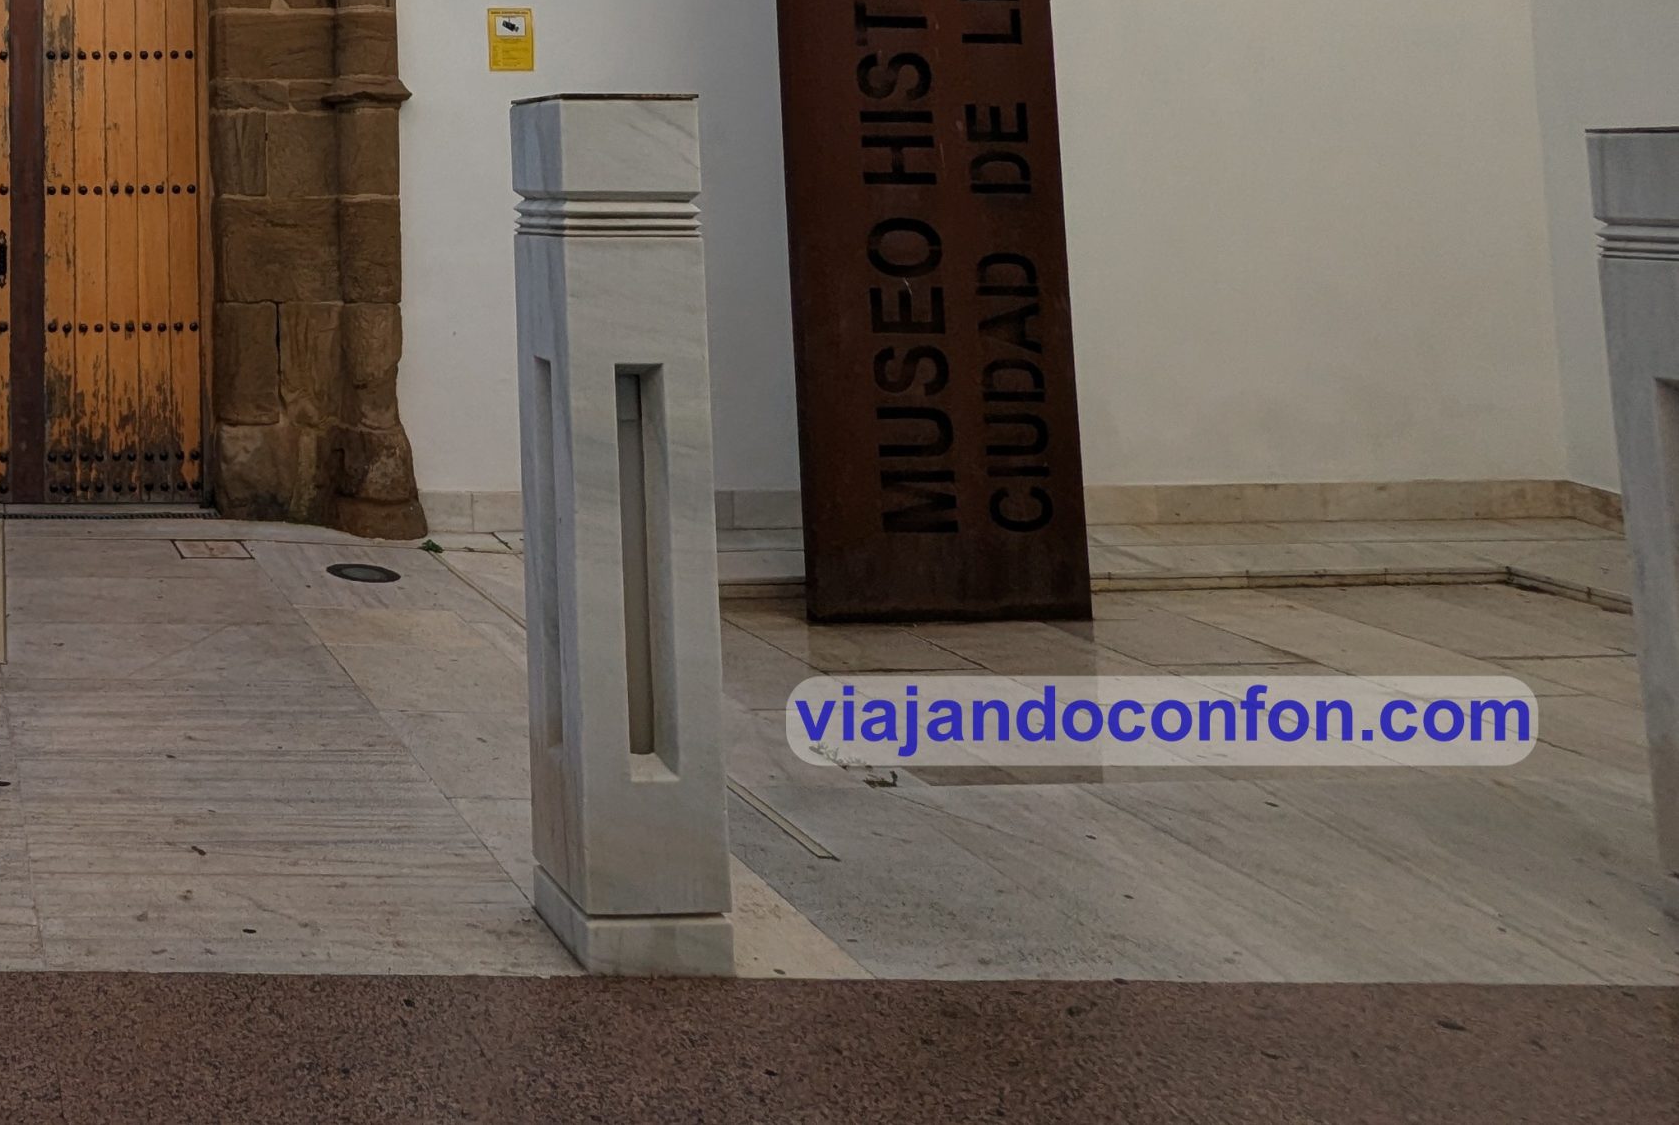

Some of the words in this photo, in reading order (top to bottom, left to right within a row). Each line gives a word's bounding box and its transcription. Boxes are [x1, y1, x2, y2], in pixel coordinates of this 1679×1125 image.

[965, 101, 1033, 195] DE
[866, 217, 960, 534] MUSEO
[976, 251, 1055, 534] CIUDAD
